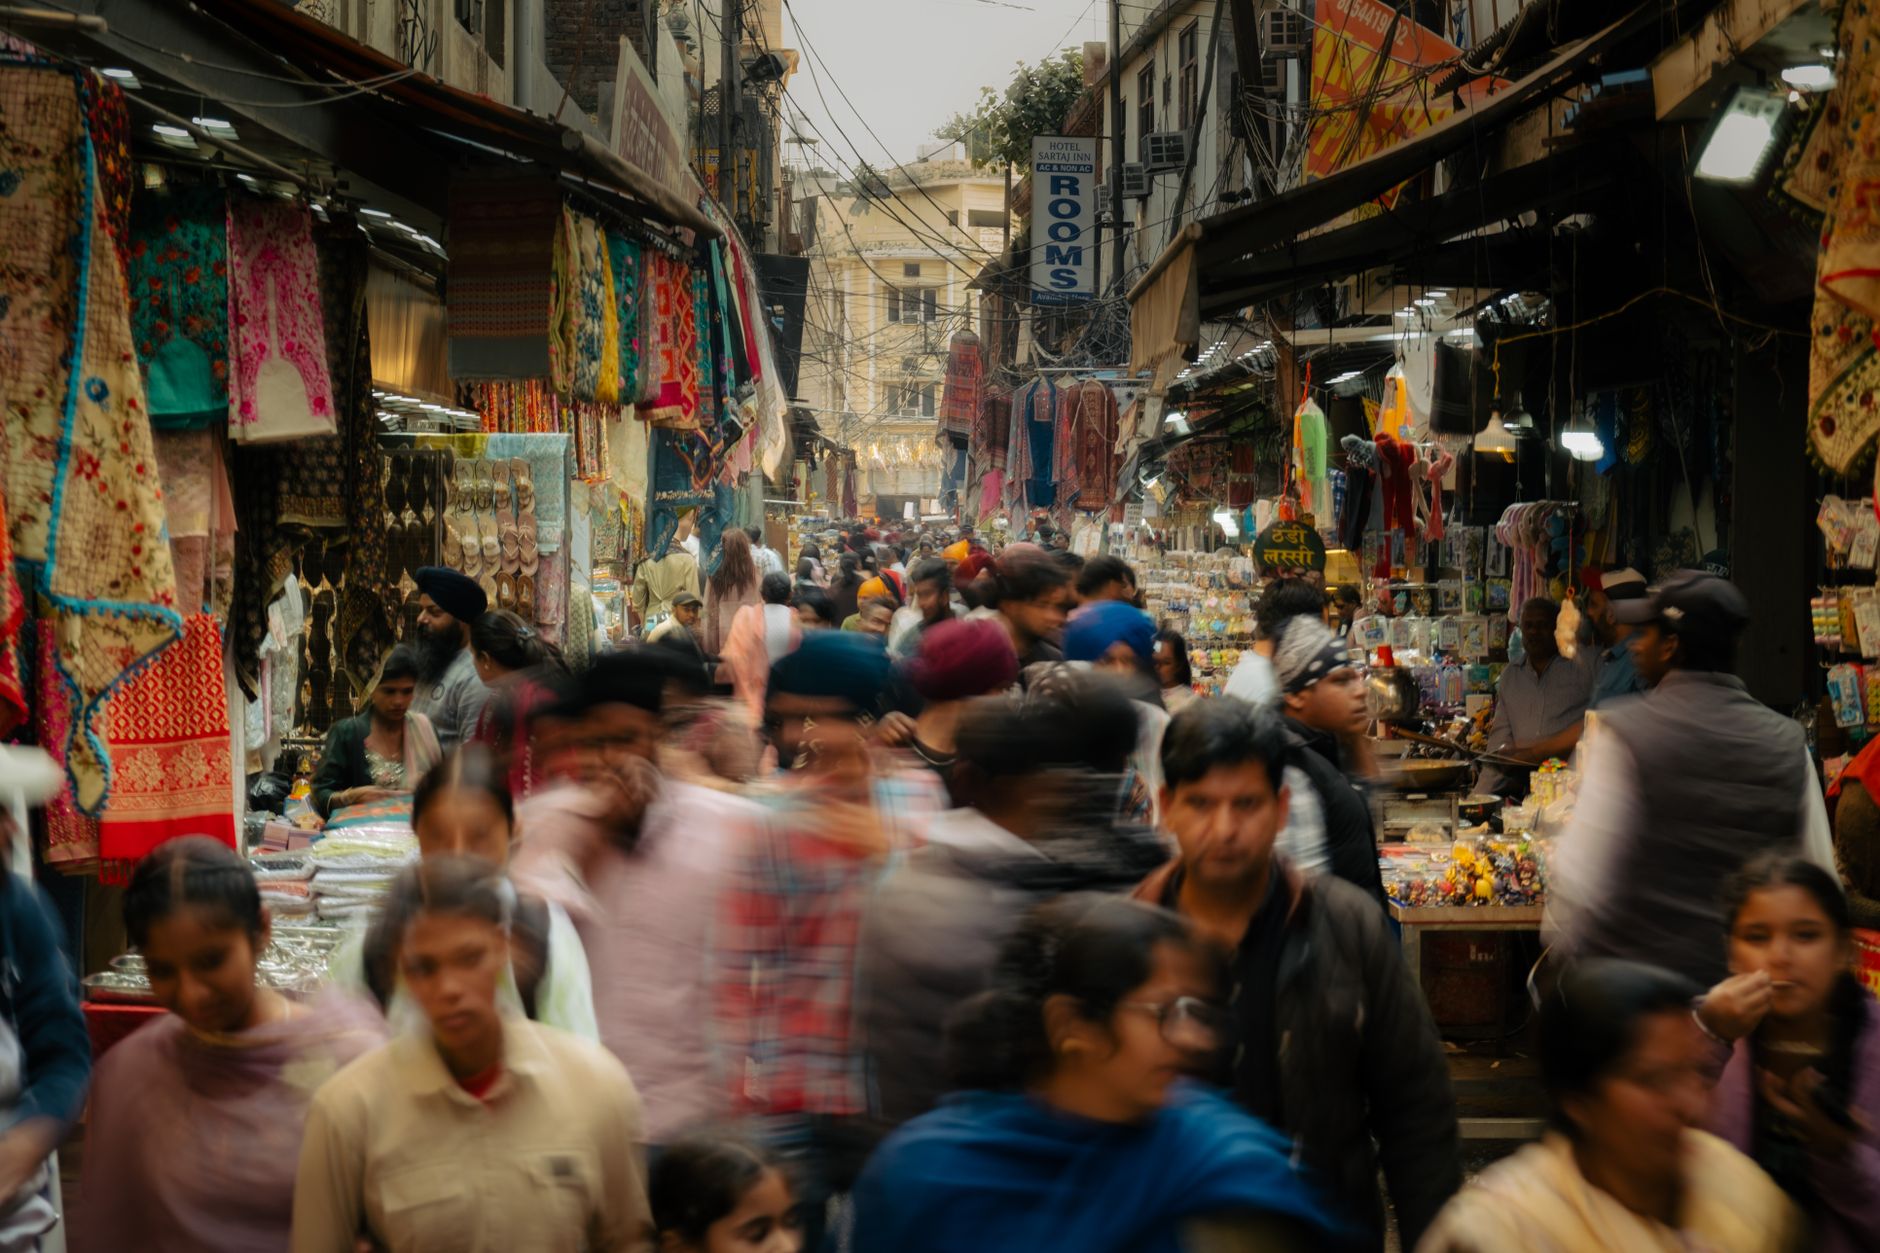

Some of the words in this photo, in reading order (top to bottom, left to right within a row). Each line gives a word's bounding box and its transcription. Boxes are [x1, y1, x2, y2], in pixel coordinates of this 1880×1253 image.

[1050, 141, 1080, 151] HOTEL
[1038, 151, 1070, 162] SARTAJ
[1073, 152, 1091, 161] INN
[1060, 164, 1077, 172] NON
[1045, 175, 1082, 289] ROOMS
[1272, 524, 1307, 544] ठंडी
[1263, 545, 1315, 566] लस्सी
